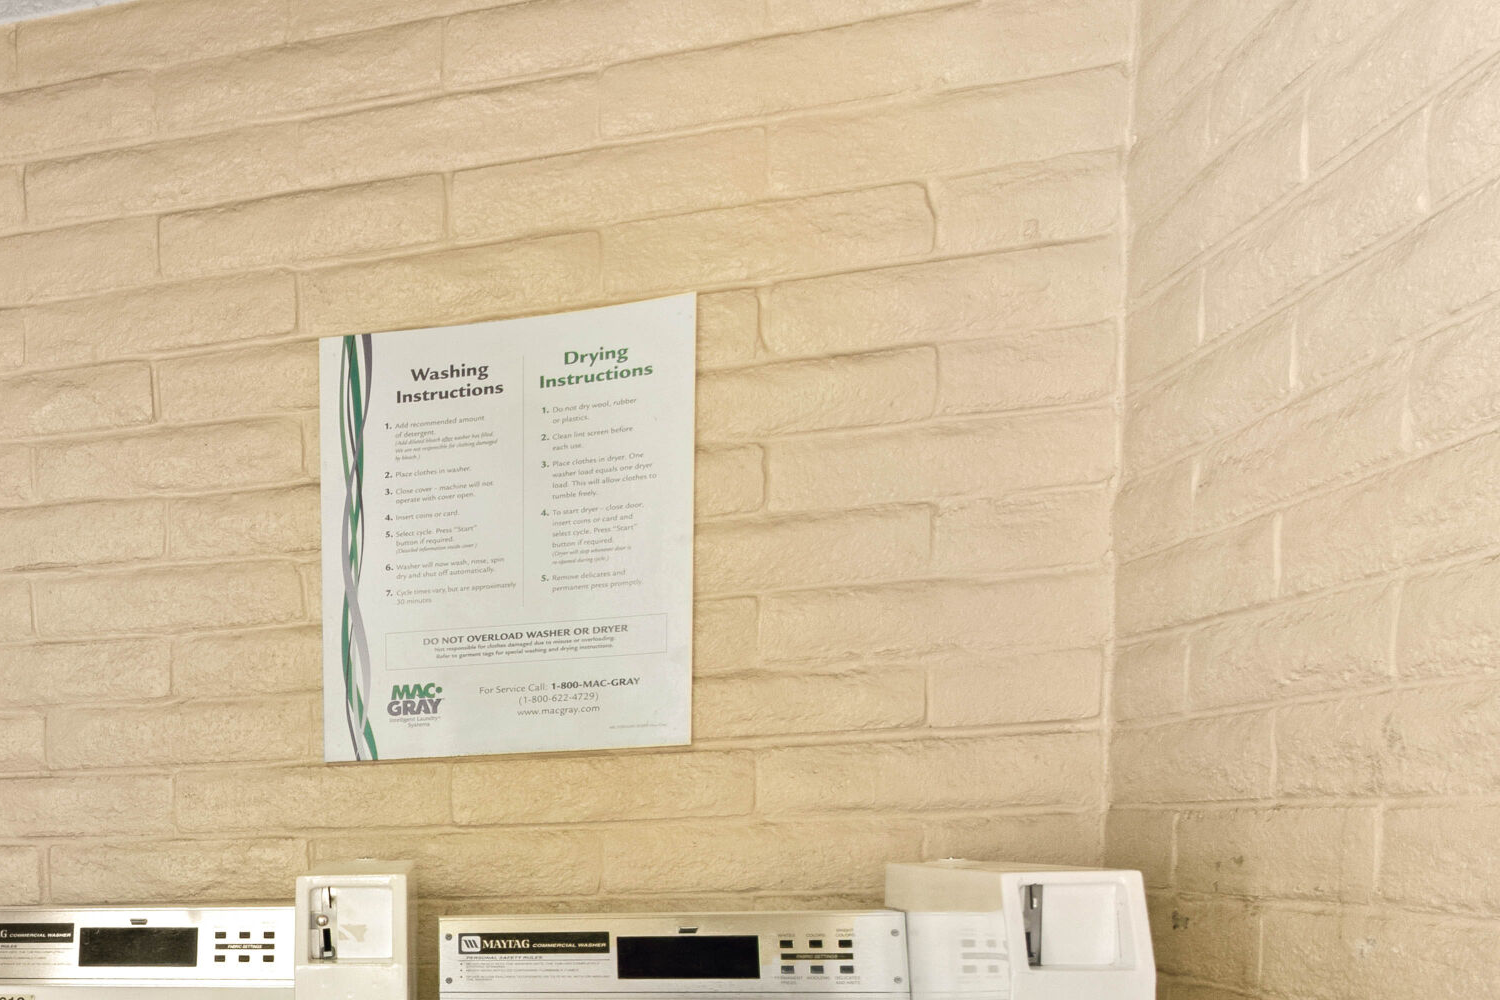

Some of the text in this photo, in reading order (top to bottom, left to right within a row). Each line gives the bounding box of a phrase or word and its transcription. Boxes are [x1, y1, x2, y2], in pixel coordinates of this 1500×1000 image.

[564, 347, 628, 367] Drying
[411, 363, 489, 382] Washing
[540, 365, 653, 388] Instructions
[397, 383, 504, 404] Instructions
[579, 403, 590, 411] dry
[613, 398, 636, 406] rubber
[410, 418, 457, 428] recommended
[459, 416, 485, 424] amount
[611, 426, 633, 434] before
[552, 443, 568, 451] each
[572, 457, 596, 465] clothes
[595, 466, 617, 475] equals
[622, 474, 647, 482] clothes
[440, 483, 466, 491] machine
[396, 496, 420, 504] operate
[422, 494, 436, 502] with
[552, 491, 576, 500] tumble
[580, 506, 598, 514] dryer
[385, 530, 393, 538] 5.
[541, 574, 549, 582] 5.
[386, 589, 393, 597] 7.
[448, 585, 458, 593] but
[472, 582, 516, 592] approximately
[442, 635, 464, 644] NOT
[467, 632, 523, 642] OVERLOAD
[526, 629, 570, 638] WASHER
[573, 627, 589, 635] OR
[593, 624, 628, 634] DRYER
[479, 677, 640, 694] For Service Call: 1-800-MAC-GRAY
[518, 692, 599, 705] (1-800-622-4729)
[387, 699, 442, 716] GRAY
[517, 705, 600, 716] www.macgray.com
[482, 939, 530, 949] MAYTAG
